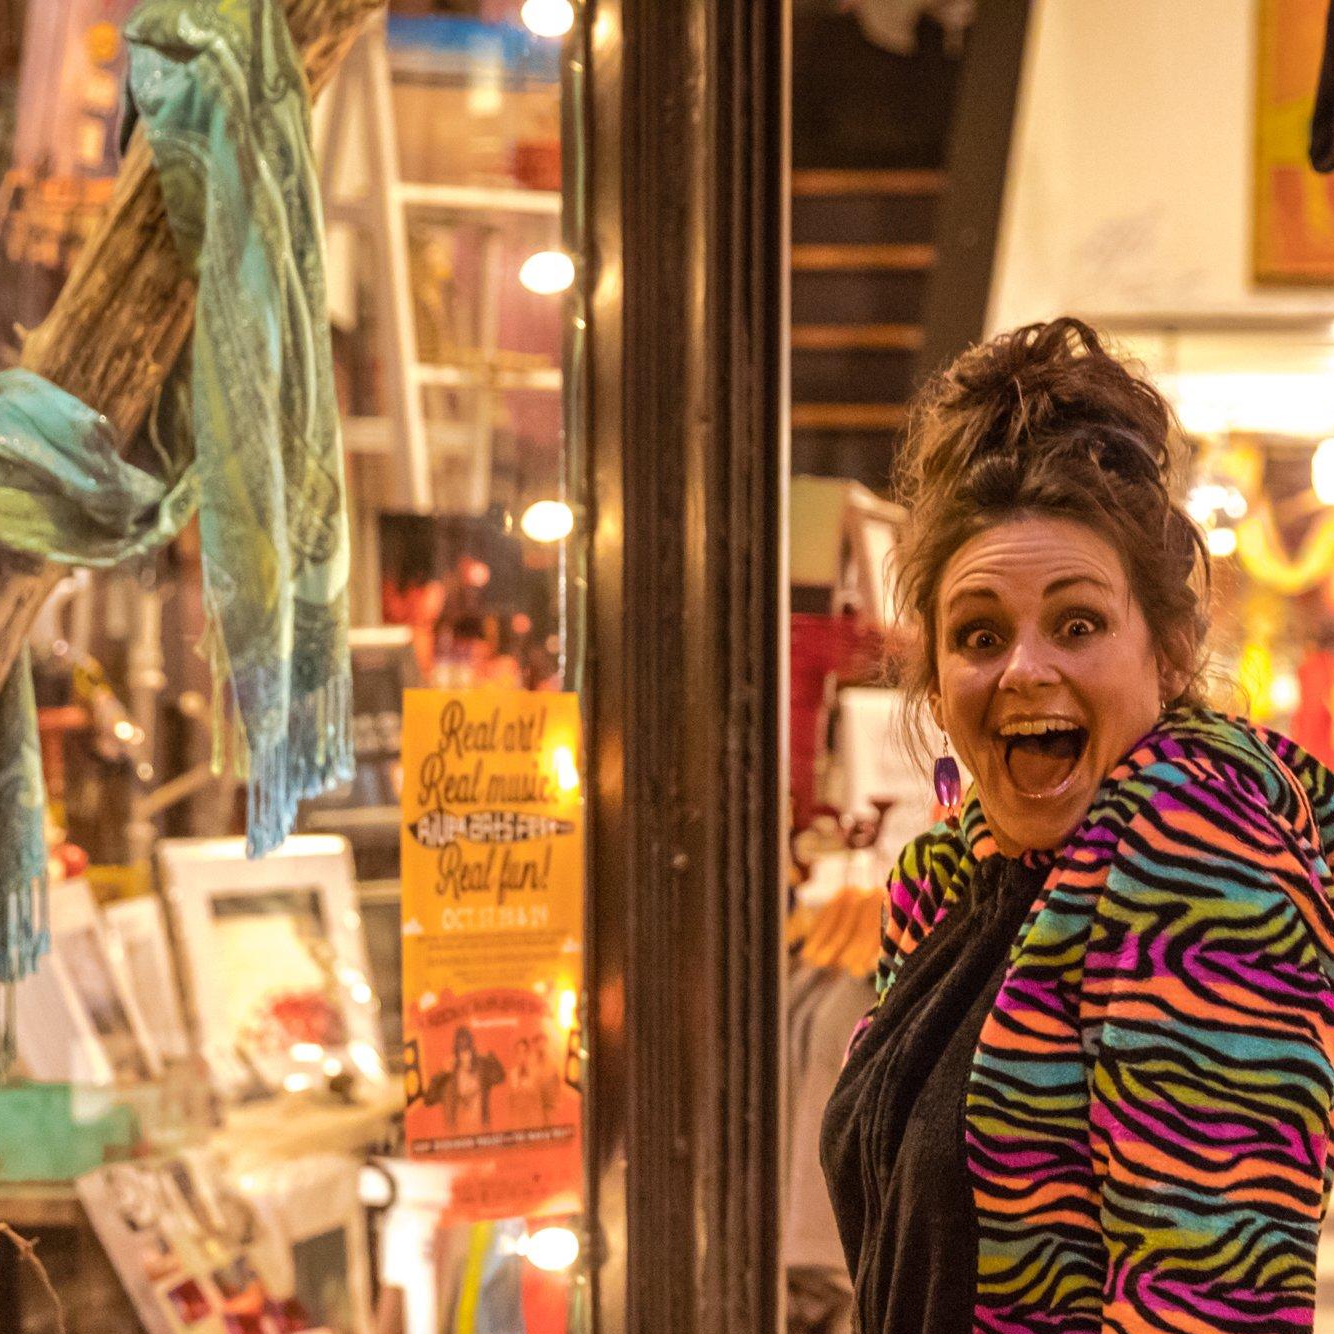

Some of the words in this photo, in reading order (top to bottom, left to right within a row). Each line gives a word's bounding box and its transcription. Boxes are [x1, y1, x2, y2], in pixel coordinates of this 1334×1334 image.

[437, 699, 501, 760] Real
[418, 752, 484, 811] Real
[435, 841, 496, 901] Real
[495, 844, 553, 906] fun!
